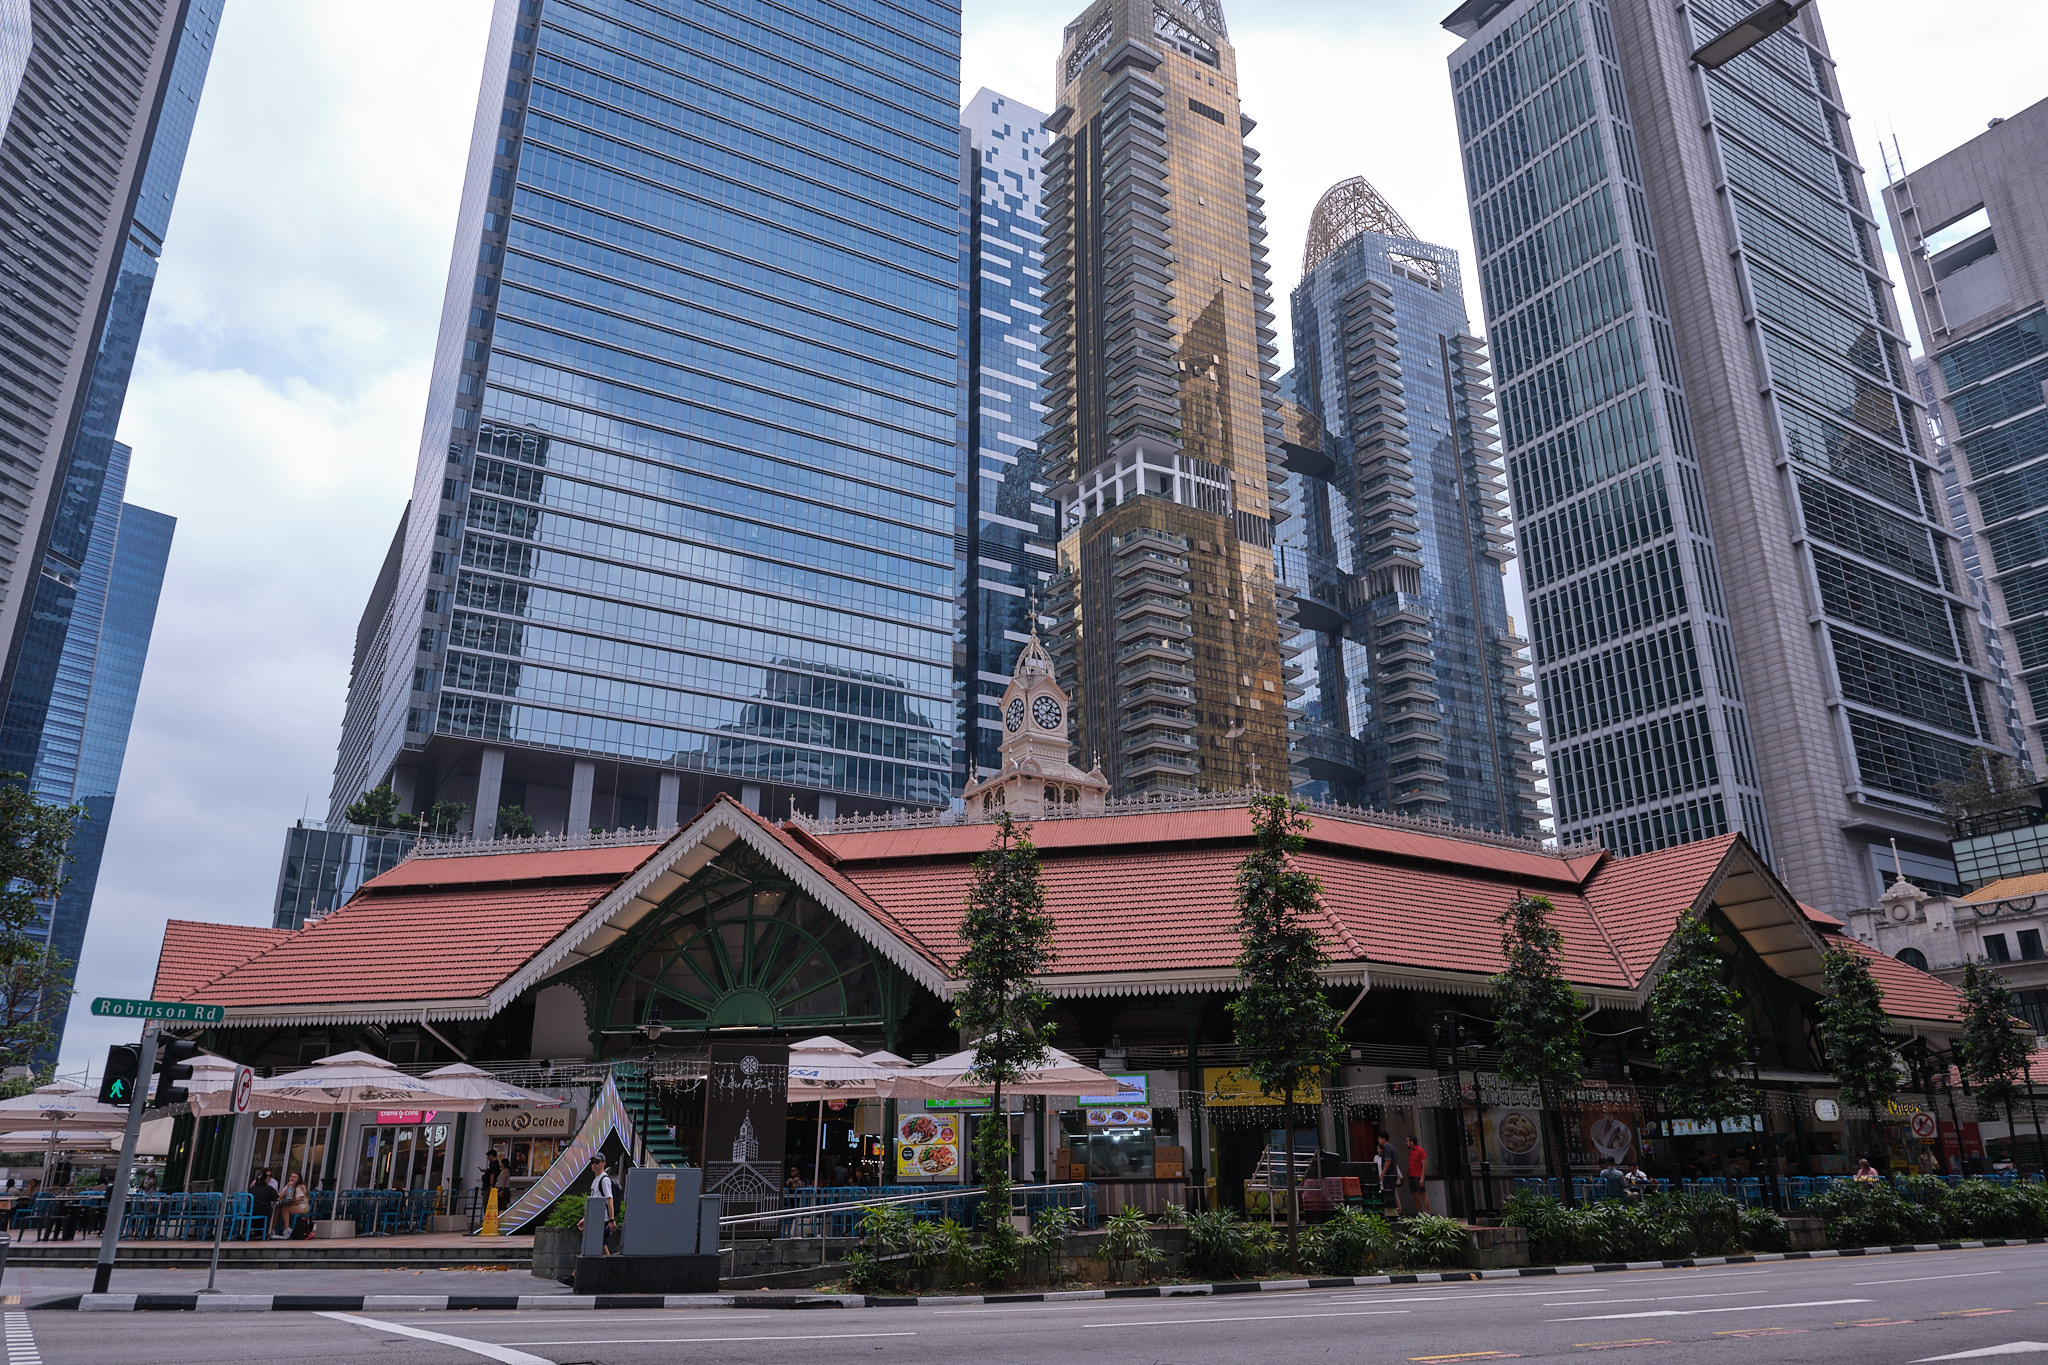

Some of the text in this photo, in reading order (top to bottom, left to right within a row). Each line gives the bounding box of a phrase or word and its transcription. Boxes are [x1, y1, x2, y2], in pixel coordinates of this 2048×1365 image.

[100, 1000, 217, 1020] Robinson Rd
[1888, 1098, 1923, 1114] Cheers
[485, 1117, 566, 1128] Hook Coffee
